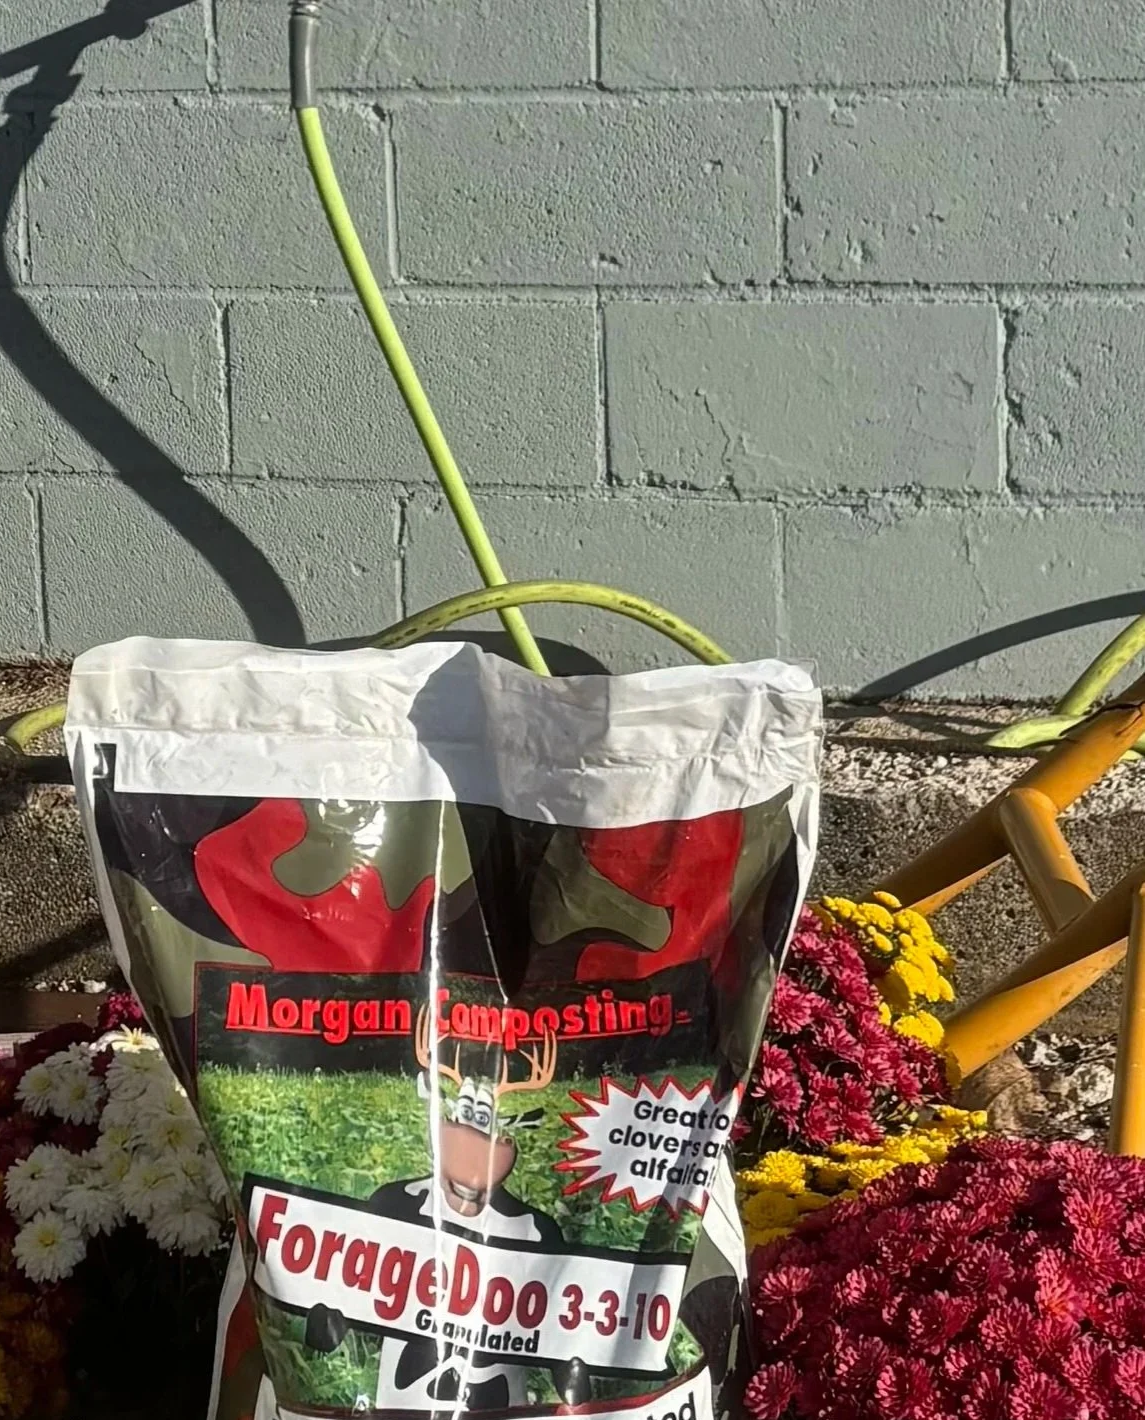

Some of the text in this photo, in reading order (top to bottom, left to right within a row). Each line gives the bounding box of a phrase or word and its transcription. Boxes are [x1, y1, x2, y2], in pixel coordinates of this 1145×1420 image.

[226, 981, 673, 1050] Morgan Composting
[634, 1100, 730, 1131] Great fo
[608, 1125, 702, 1157] clovers
[630, 1157, 716, 1188] alfalfa!
[558, 1283, 671, 1342] 3-3-10
